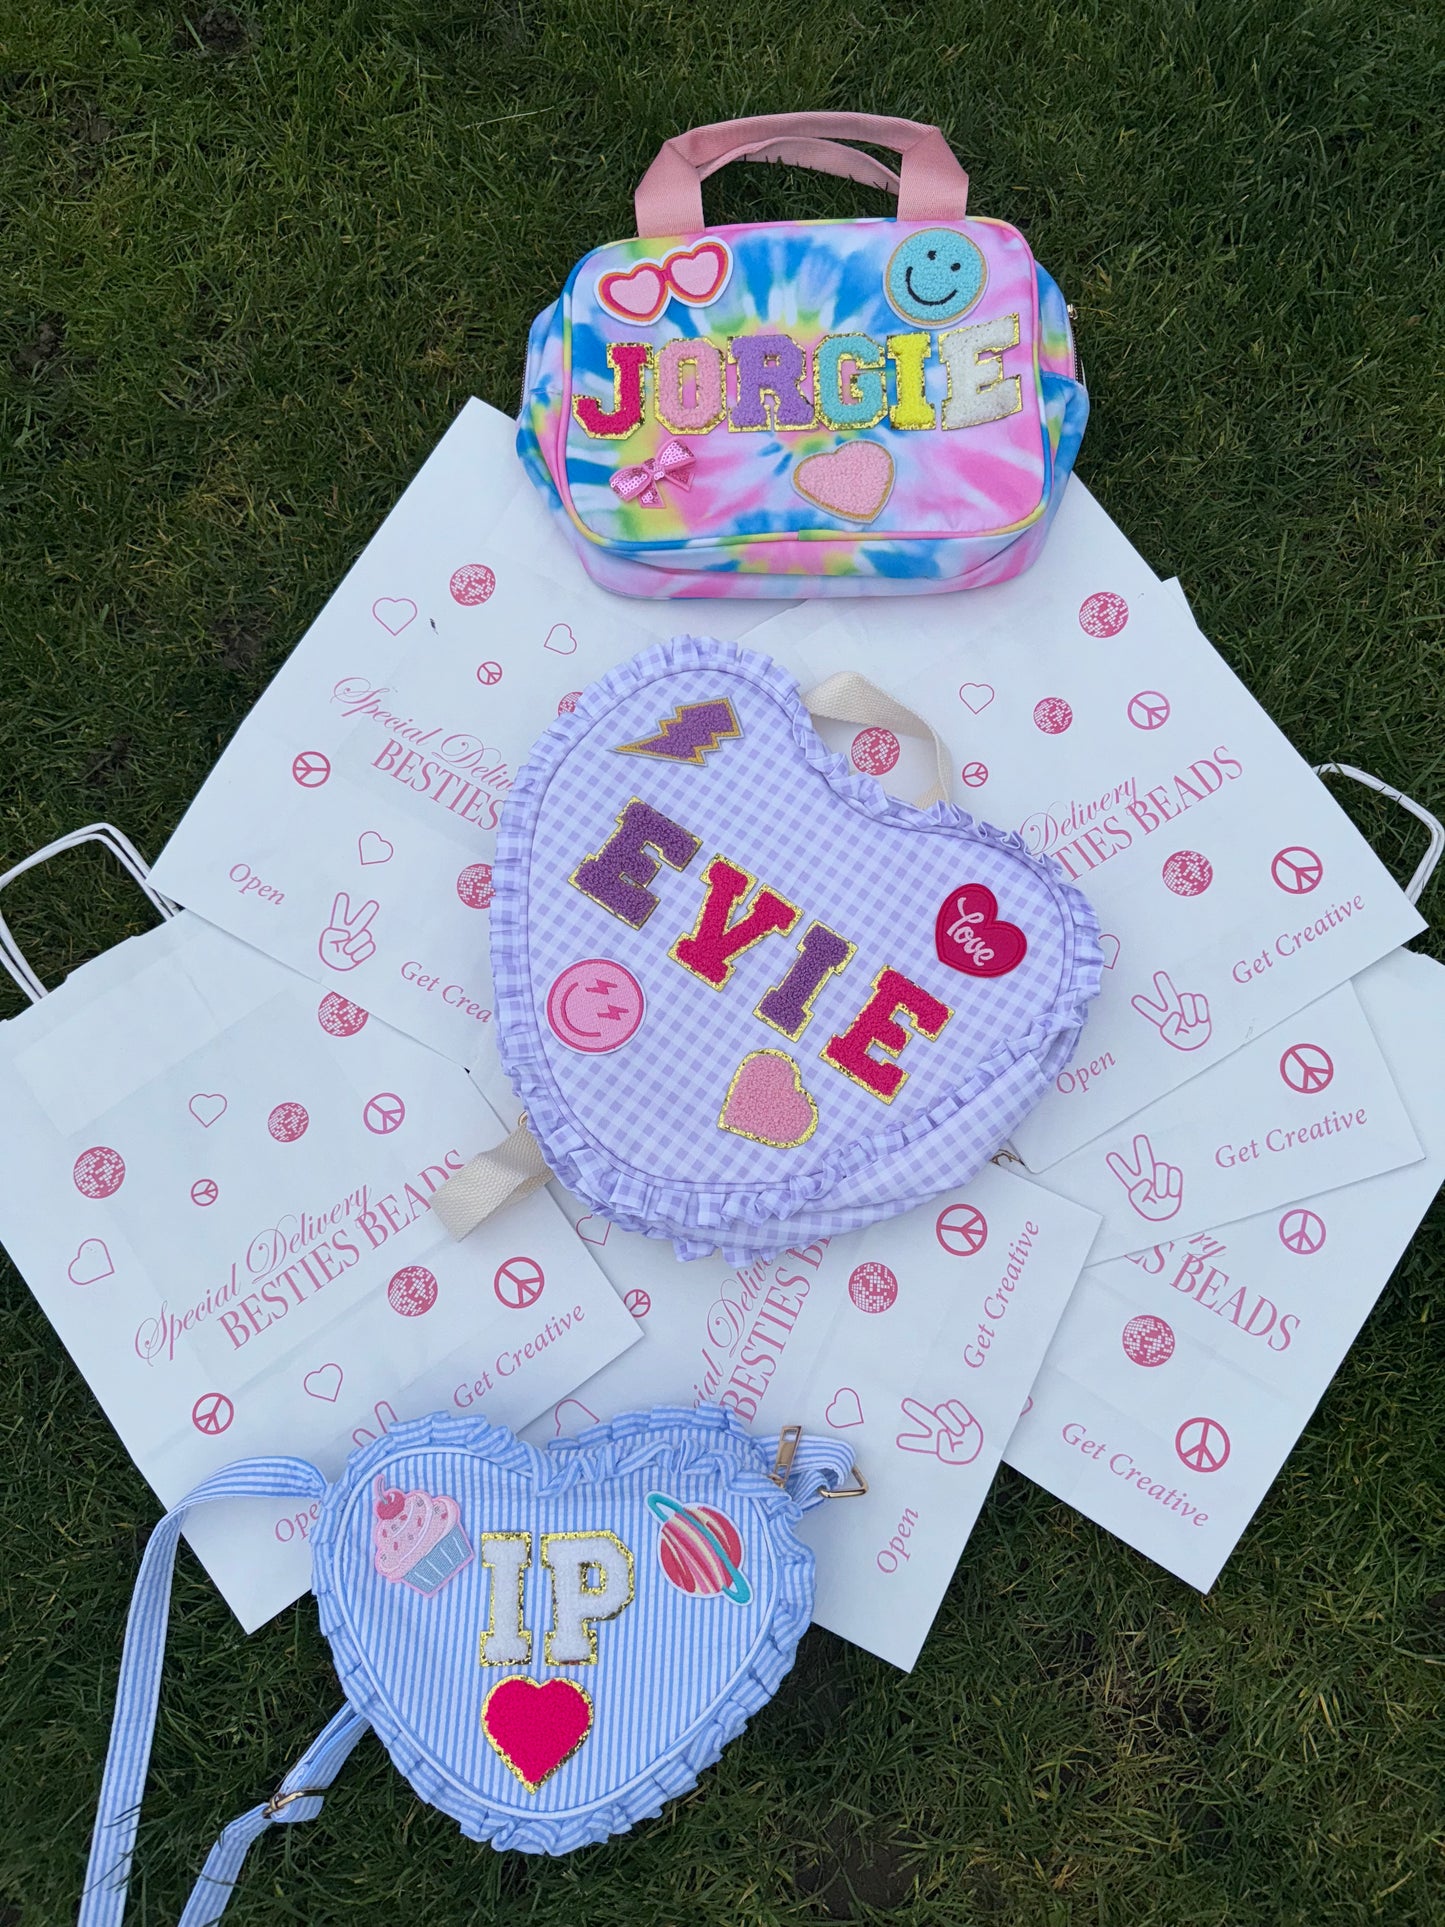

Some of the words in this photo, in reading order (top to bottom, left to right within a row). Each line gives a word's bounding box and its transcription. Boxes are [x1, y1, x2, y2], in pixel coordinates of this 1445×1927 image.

[572, 312, 1023, 440] JORGIE
[330, 677, 444, 746] Special
[431, 733, 515, 793] Deliv
[370, 738, 507, 831] BESTIES
[1019, 776, 1139, 857] Delivery
[1049, 815, 1134, 882] TIES
[1124, 744, 1243, 836] BEADS
[229, 863, 285, 905] Open
[568, 796, 955, 1106] EVIE
[1232, 949, 1274, 984] Get
[1275, 894, 1366, 957] Creative
[401, 961, 441, 992] Get
[442, 984, 493, 1023] Crea
[1056, 1051, 1116, 1094] Open
[1215, 1139, 1260, 1169] Get
[1265, 1108, 1368, 1152] Creative
[134, 1262, 242, 1368] Special
[246, 1184, 372, 1285] Delivery
[216, 1229, 360, 1350] BESTIES
[706, 1256, 773, 1359] Deliv
[963, 1323, 995, 1369] Get
[983, 1220, 1040, 1321] Creative
[1169, 1251, 1301, 1352] BEADS
[453, 1371, 494, 1408] Get
[495, 1305, 586, 1377] Creative
[719, 1266, 811, 1425] BESTIES
[275, 1499, 322, 1542] Ope
[1062, 1422, 1107, 1460] Get
[1109, 1453, 1209, 1527] Creative
[876, 1507, 919, 1574] Open
[480, 1530, 636, 1668] IP
